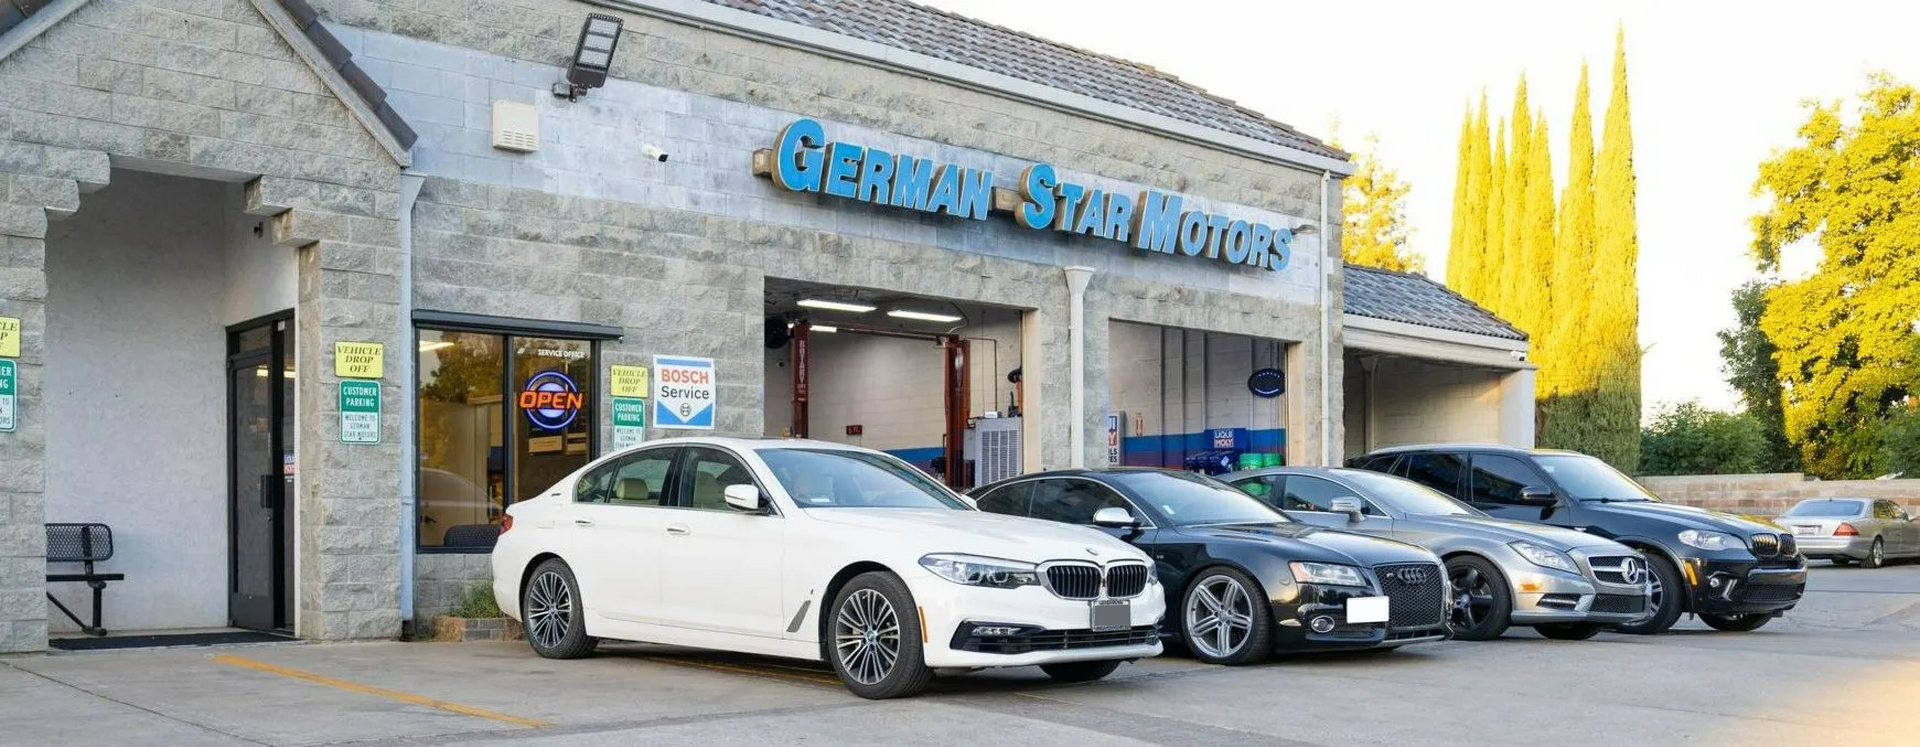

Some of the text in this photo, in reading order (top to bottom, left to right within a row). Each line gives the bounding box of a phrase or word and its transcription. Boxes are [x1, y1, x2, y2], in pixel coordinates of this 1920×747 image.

[775, 116, 1293, 272] GERMAN STAR MOTORS
[337, 345, 381, 355] VEHICLE
[538, 349, 562, 357] SERVICE
[345, 355, 374, 364] DROP
[350, 365, 369, 373] OFF
[612, 368, 646, 377] VEHICLE
[618, 377, 641, 385] DROP
[661, 369, 709, 384] BOSCH
[343, 386, 377, 396] CUSTOMER
[622, 385, 638, 393] OFF
[661, 385, 709, 400] Service
[346, 398, 375, 407] PARKING
[520, 391, 583, 409] OPEN
[615, 403, 642, 412] CUSTOMER
[617, 413, 640, 422] PARKING
[1214, 439, 1234, 448] MOLY
